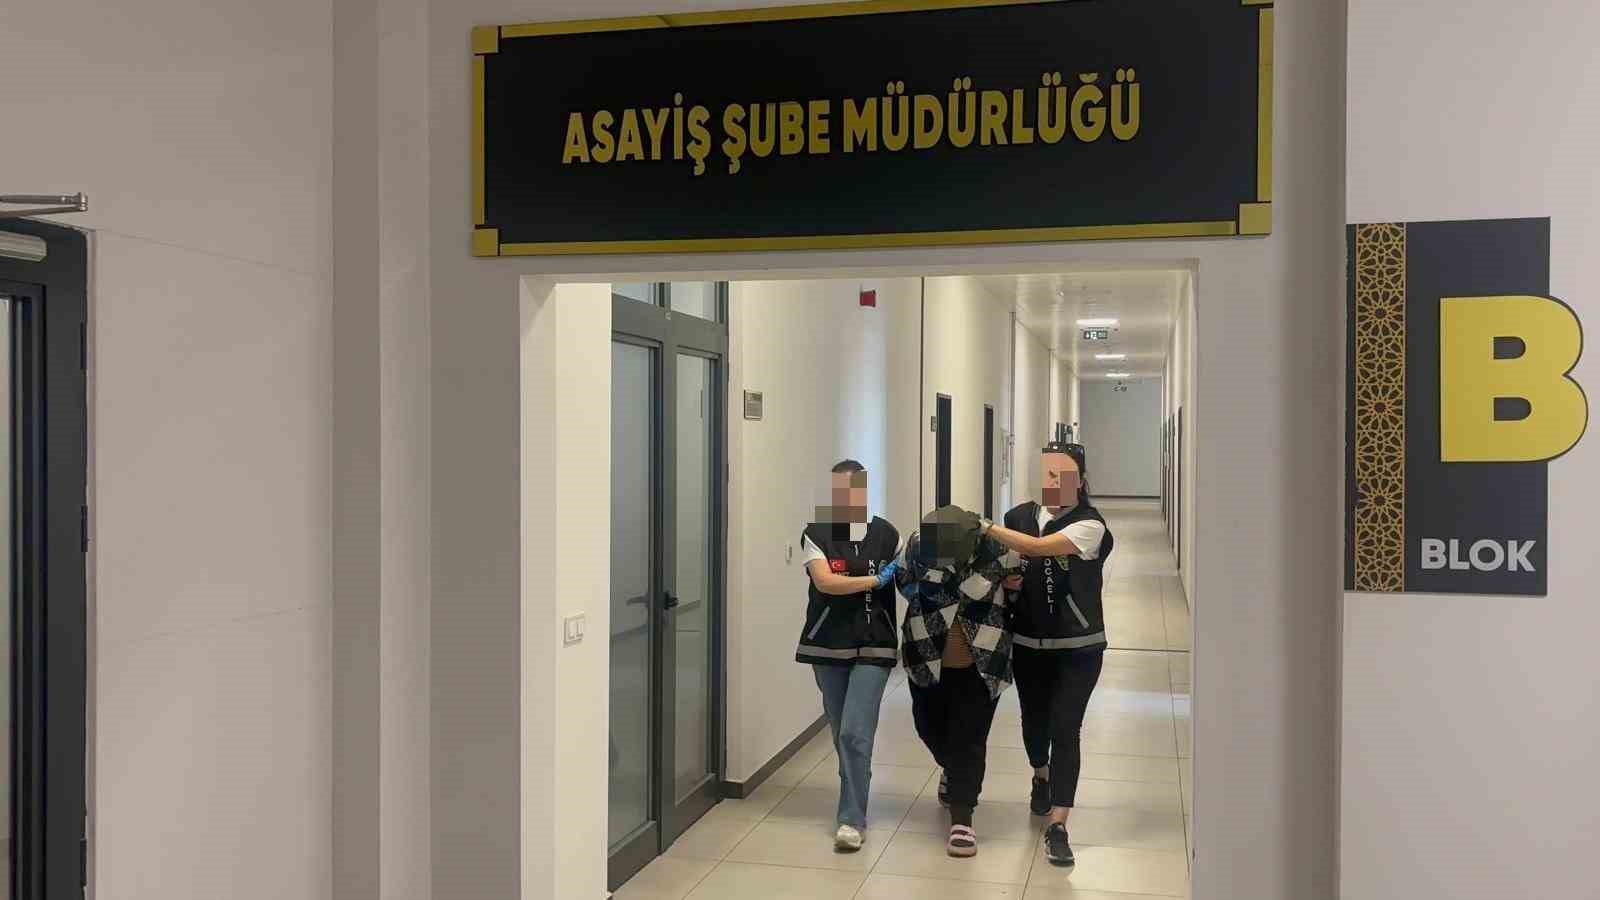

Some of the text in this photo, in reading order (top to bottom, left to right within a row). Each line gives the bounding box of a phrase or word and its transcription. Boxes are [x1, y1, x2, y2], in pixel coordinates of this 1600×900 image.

[562, 68, 1140, 175] ASAYİŞ ŞUBE MÜDÜRLÜĞÜ
[1440, 295, 1588, 462] B
[1421, 538, 1537, 572] BLOK
